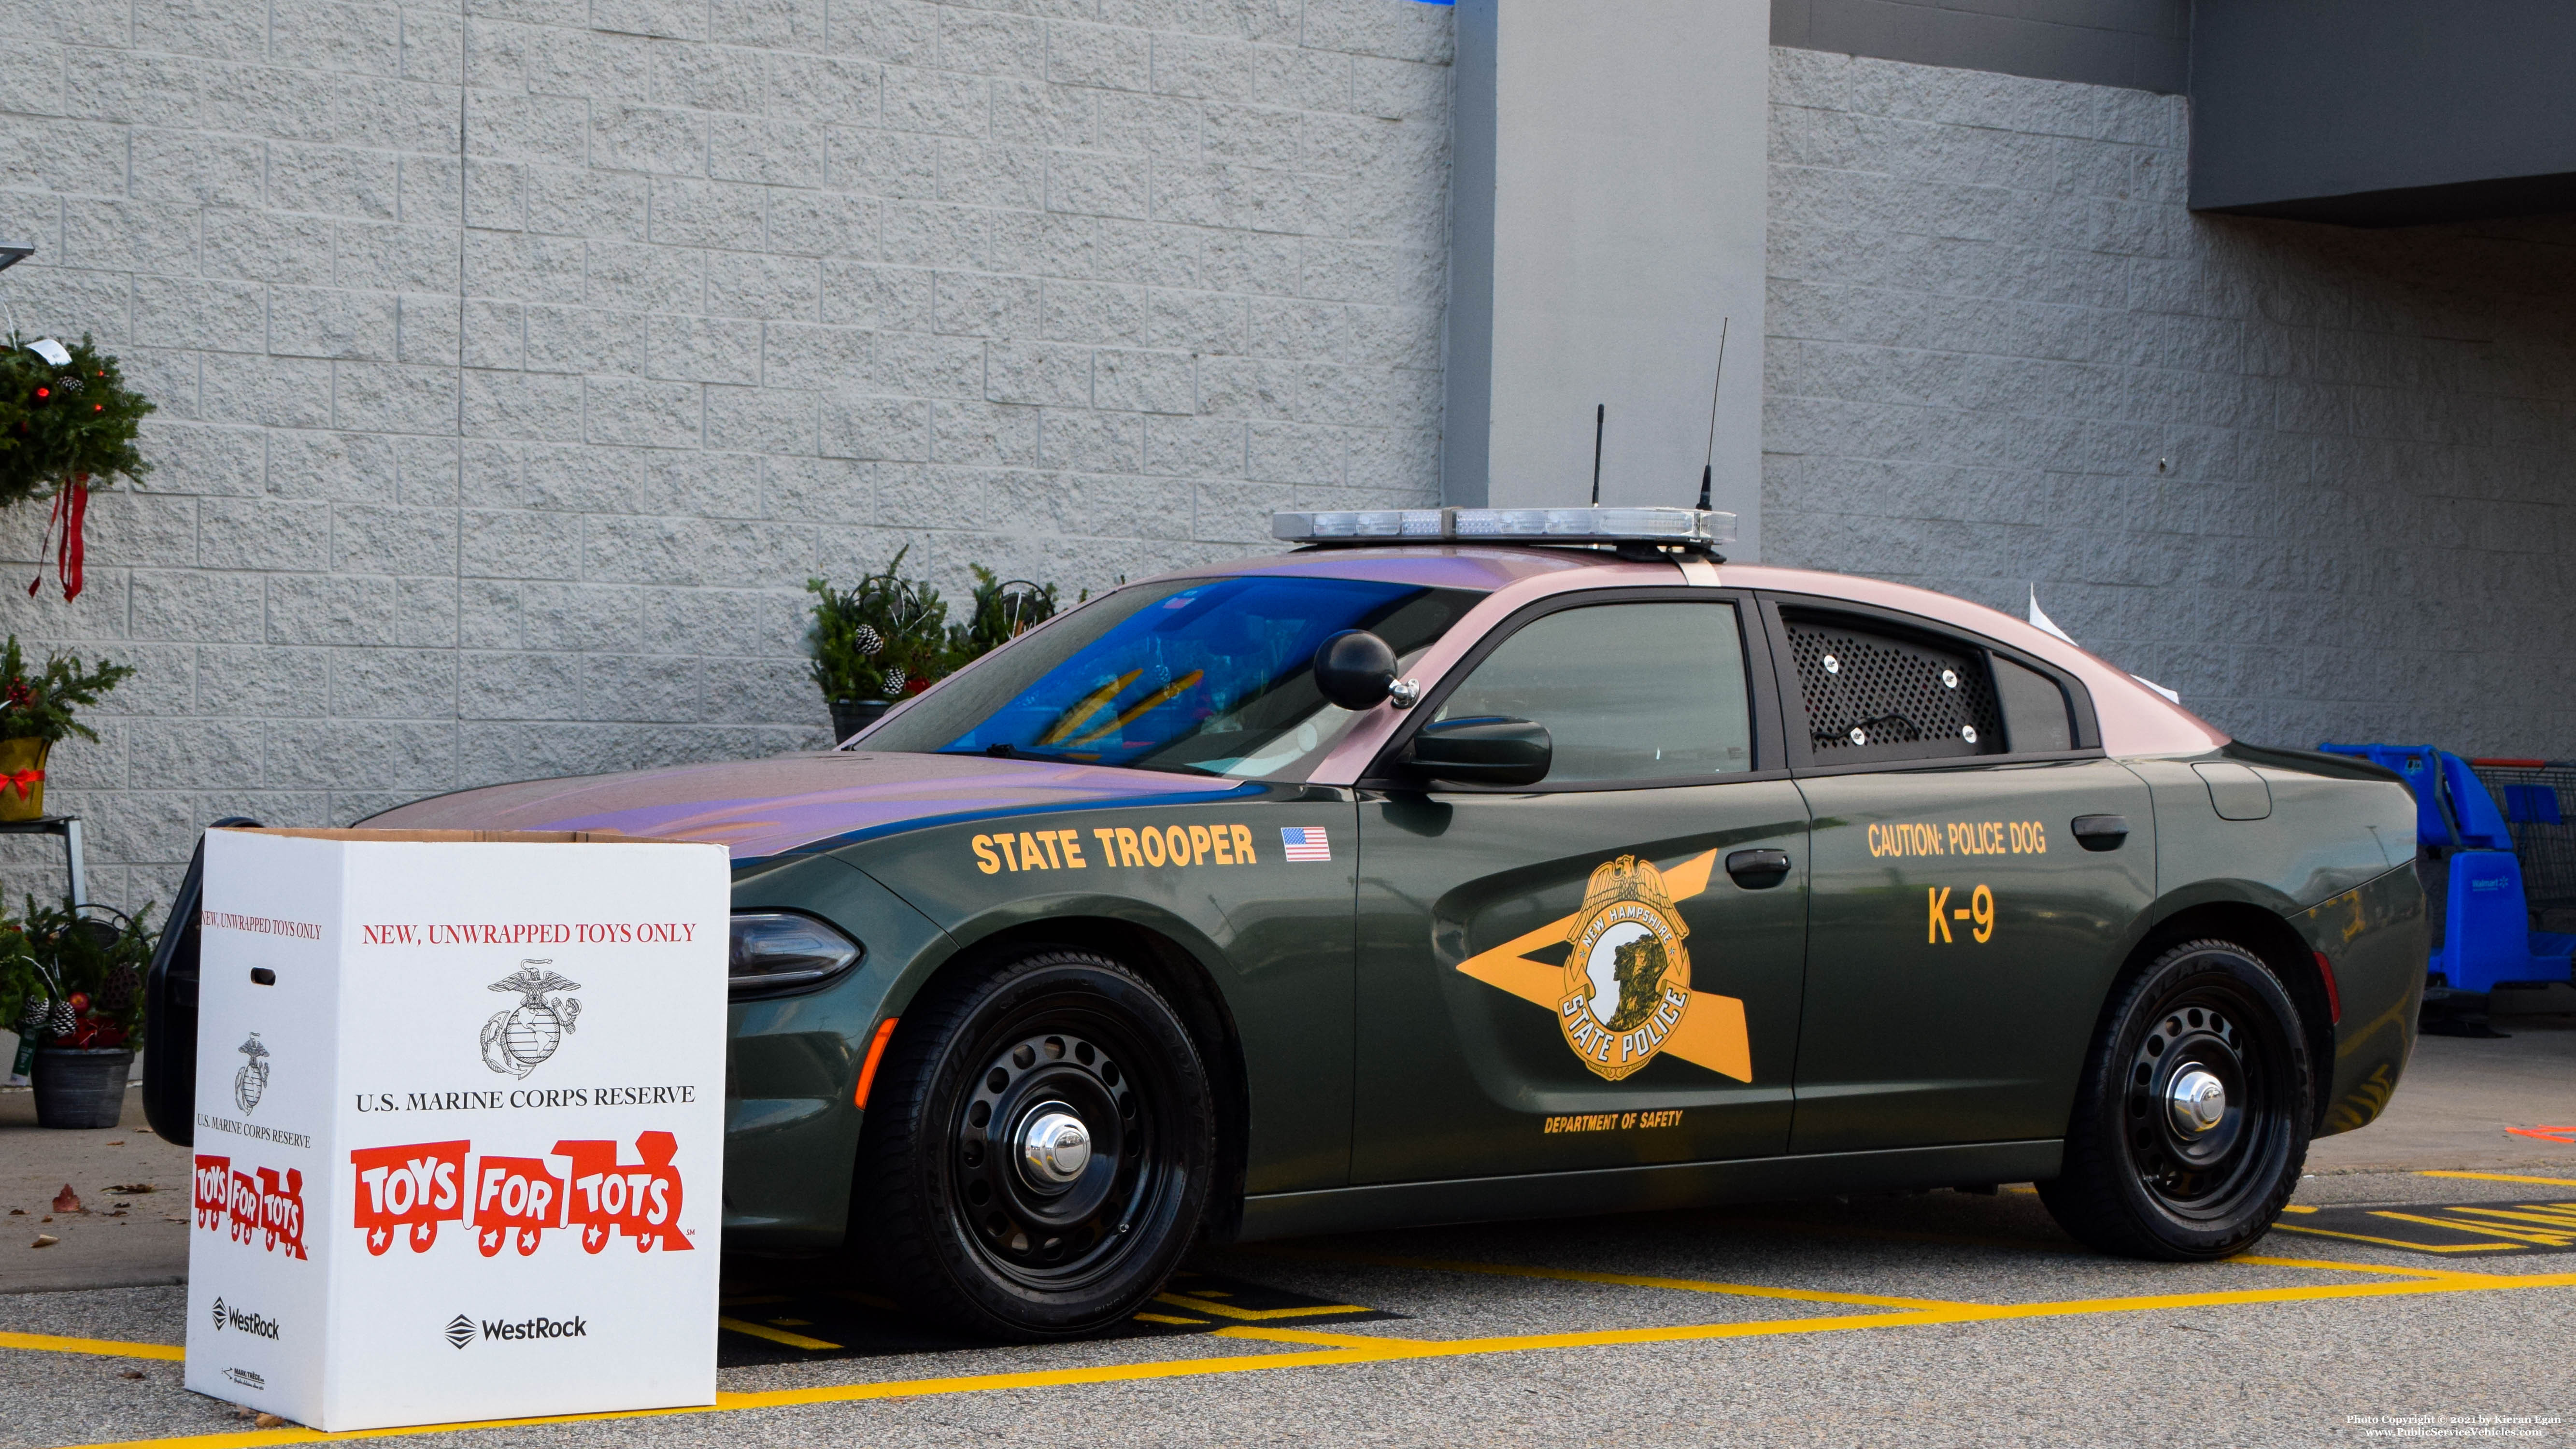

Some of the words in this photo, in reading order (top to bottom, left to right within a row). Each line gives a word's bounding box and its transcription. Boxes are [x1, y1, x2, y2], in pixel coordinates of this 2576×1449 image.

[972, 829, 1086, 874] STATE
[1093, 824, 1257, 867] TROOPER
[1868, 823, 1944, 857] CAUTION:
[1948, 822, 2006, 855] POLICE
[2009, 821, 2046, 853] DOG
[2473, 879, 2498, 888] Walmart
[221, 912, 270, 933] UNWRAPPED
[273, 920, 294, 937] TOYS
[297, 922, 321, 939] ONLY
[1582, 916, 1605, 948] NEW
[1609, 906, 1672, 944] HAMPSHIRE
[1929, 884, 1994, 943] K-9
[362, 924, 422, 947] NEW,
[428, 924, 570, 944] UNWRAPPED
[575, 924, 631, 943] TOYS
[636, 923, 697, 943] ONLY
[1563, 994, 1614, 1062] STATE
[1622, 986, 1687, 1062] POLICE
[356, 1094, 399, 1112] U.S.
[407, 1091, 504, 1111] MARINE
[510, 1088, 587, 1108] CORPS
[593, 1086, 696, 1106] RESERVE
[198, 1113, 210, 1127] U.S.
[212, 1116, 242, 1135] MARINE
[243, 1123, 270, 1140] CORPS
[272, 1129, 311, 1149] RESERVE
[1544, 1113, 1618, 1134] DEPARTMENT
[1621, 1113, 1637, 1129] OF
[1640, 1110, 1682, 1128] SAFETY
[198, 1165, 226, 1204] TOYS
[232, 1179, 256, 1221] FOR
[264, 1194, 299, 1238] TOTS
[361, 1156, 456, 1215] TOYS
[479, 1168, 552, 1220] FOR
[576, 1173, 669, 1225] TOTS
[228, 1306, 279, 1340] WestRock
[482, 1315, 587, 1341] WestRock
